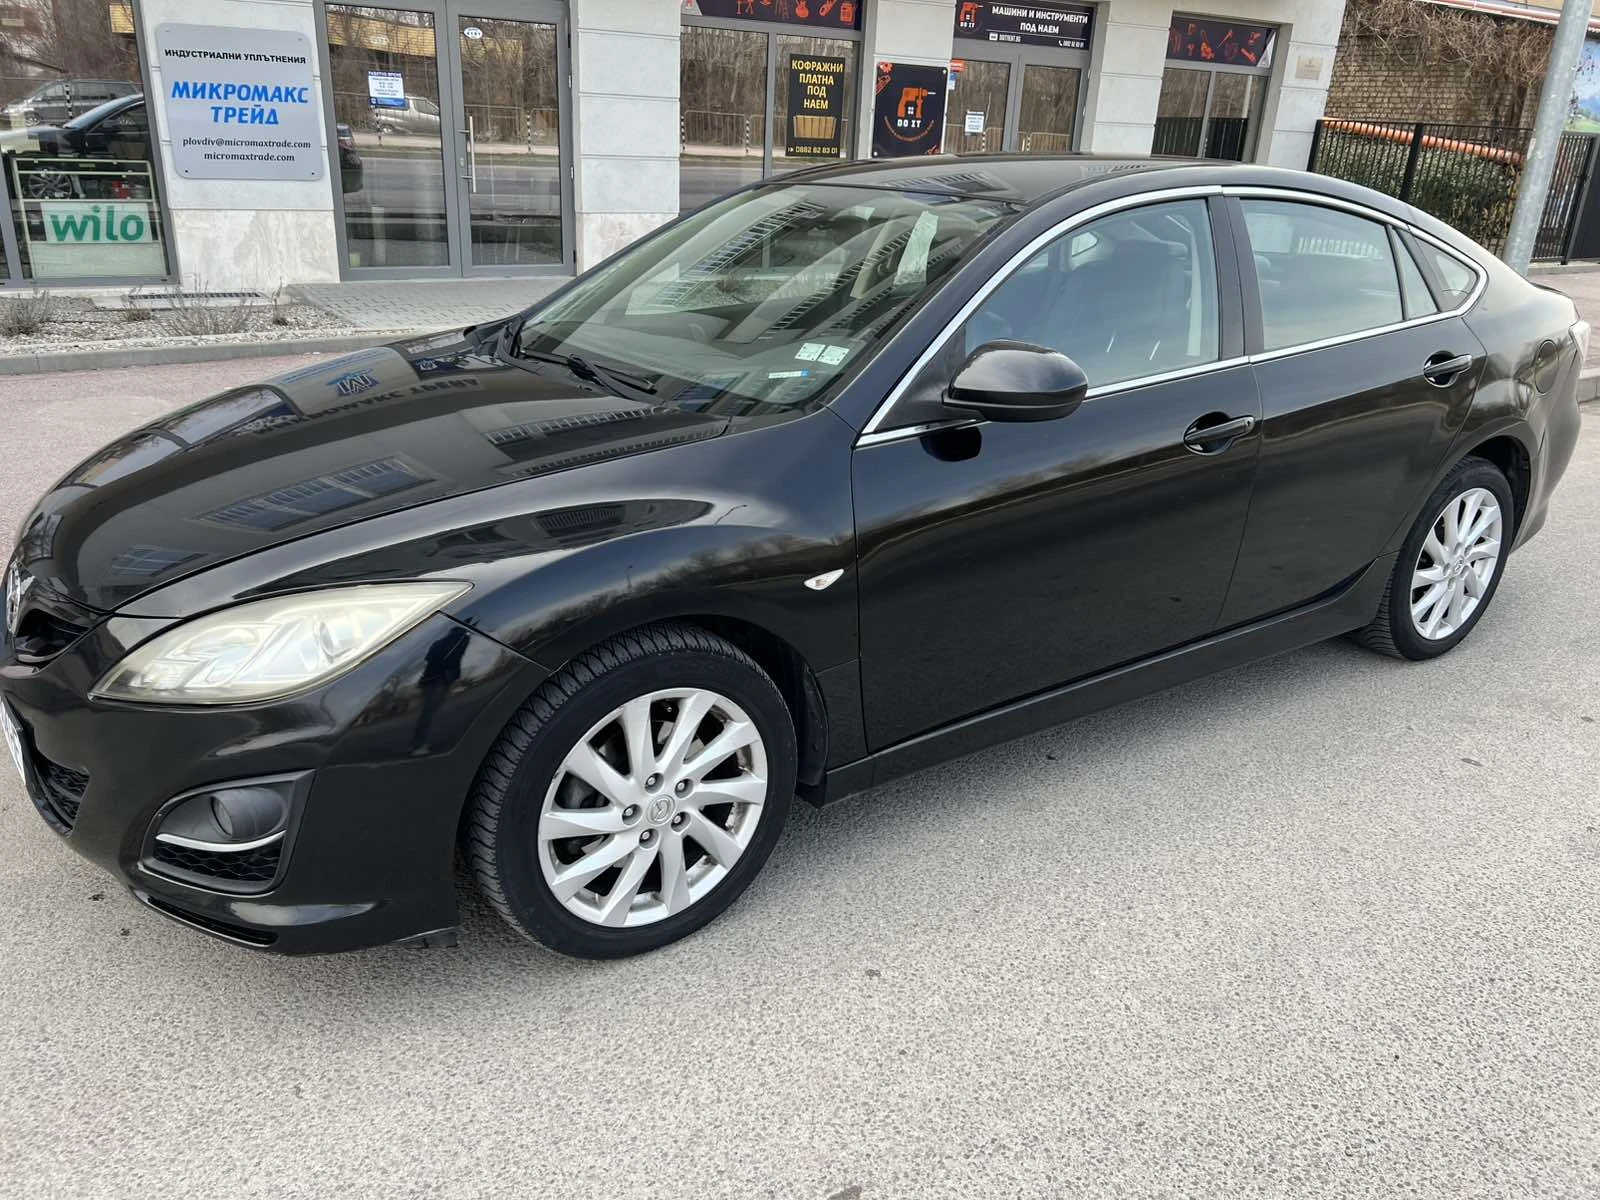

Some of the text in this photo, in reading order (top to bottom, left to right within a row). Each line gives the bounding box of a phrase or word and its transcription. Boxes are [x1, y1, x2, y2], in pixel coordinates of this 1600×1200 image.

[992, 6, 1088, 24] МАШИНИ И ИНСТРУМЕНТИ
[1020, 22, 1059, 34] ПОД НАЕМ
[164, 49, 307, 64] ИНДУСТРИАЛНИ УПЛЪТНЕНИЯ
[791, 60, 843, 73] КОФРАЖНИ
[799, 73, 834, 85] ПЛАТНА
[171, 81, 309, 103] МИКРОМАКС
[807, 85, 826, 98] ПОД
[803, 98, 828, 110] НАЕМ
[210, 104, 279, 125] ТРЕЙД
[897, 119, 921, 128] DO IT
[182, 137, 311, 149] plovdiv@micromaxtrade.com
[203, 152, 295, 162] micromaxtrade.com
[50, 205, 144, 241] wilo
